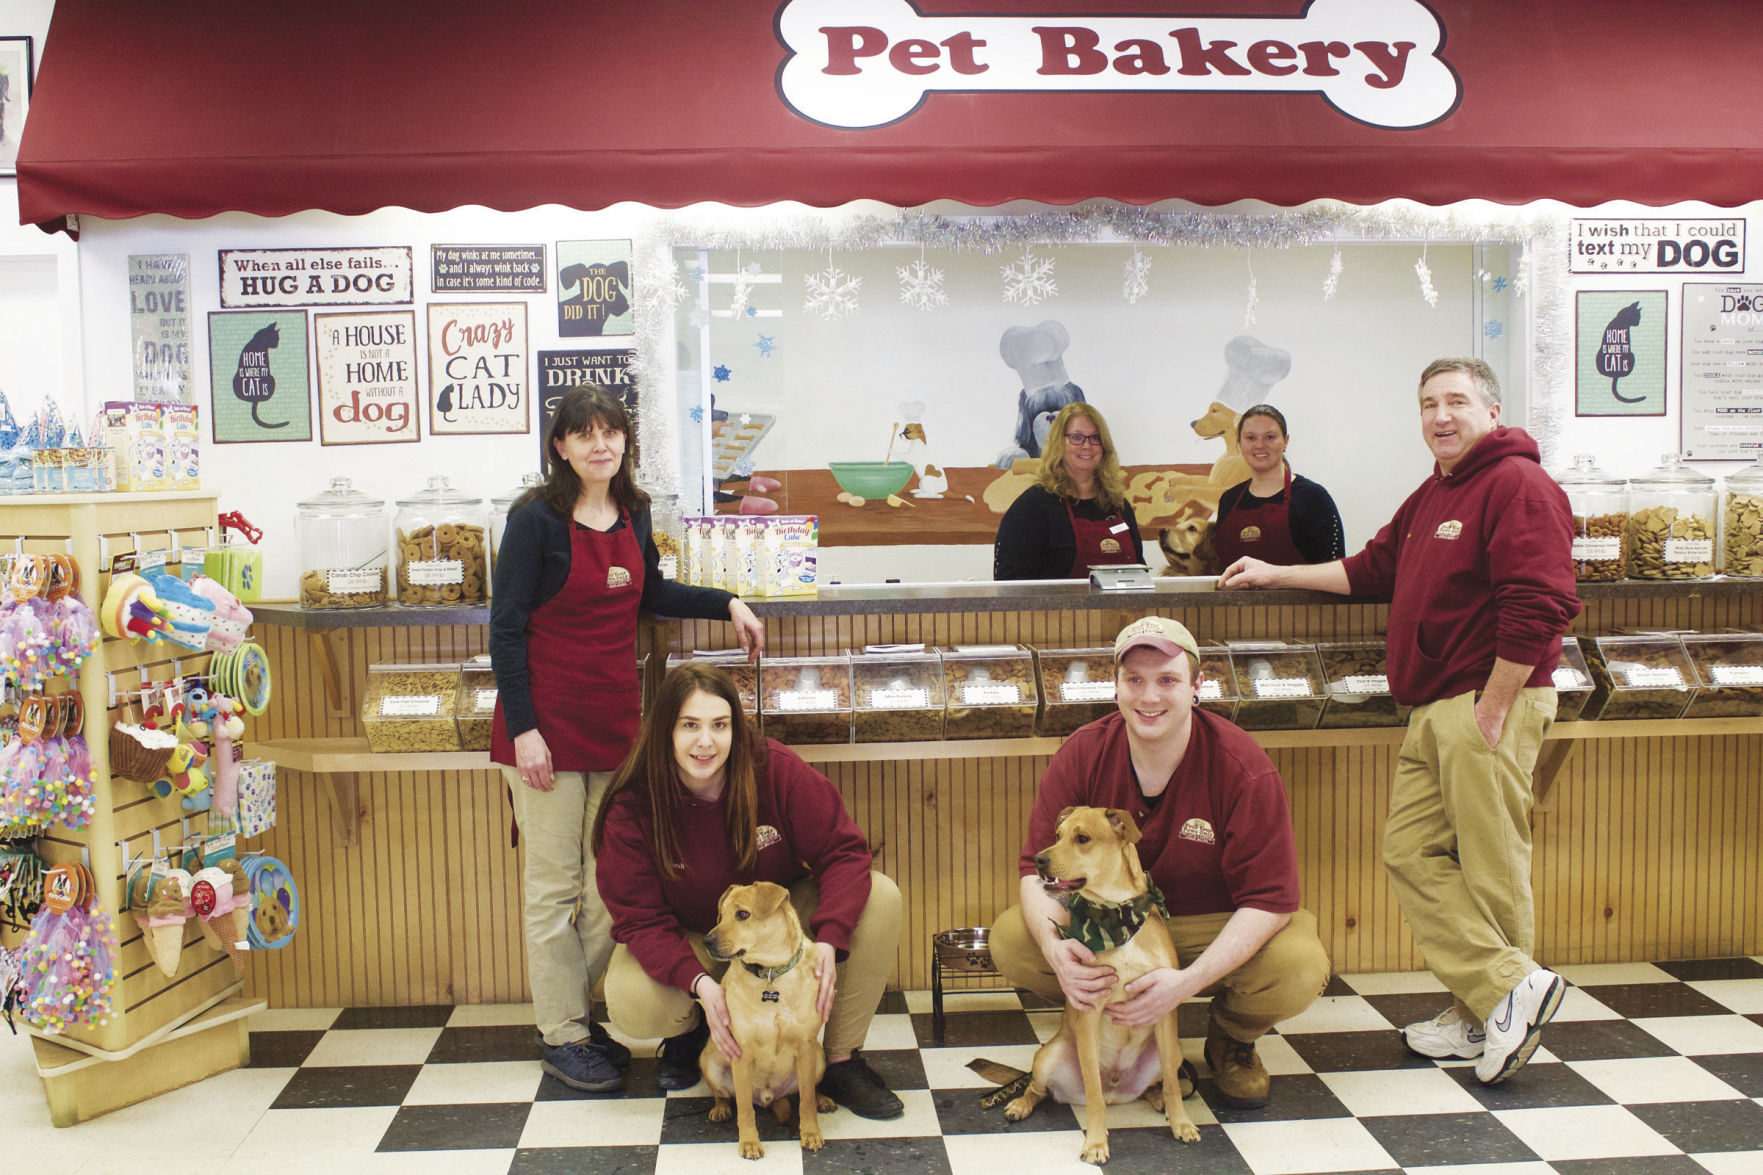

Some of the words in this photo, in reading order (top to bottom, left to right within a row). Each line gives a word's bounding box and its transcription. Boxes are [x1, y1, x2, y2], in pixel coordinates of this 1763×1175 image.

[818, 25, 990, 76] Pet
[1031, 25, 1417, 89] Bakery
[1577, 223, 1583, 237] I
[1589, 223, 1629, 237] wish
[1634, 223, 1667, 237] that
[1675, 223, 1681, 237] I
[1688, 223, 1737, 237] could
[436, 250, 446, 262] My
[447, 250, 460, 262] dog
[461, 250, 479, 260] winks
[481, 251, 489, 260] at
[490, 251, 501, 260] me
[1577, 240, 1615, 255] text
[1620, 243, 1653, 260] my
[1656, 239, 1739, 268] DOG
[233, 259, 281, 272] When
[285, 258, 306, 271] all
[310, 258, 343, 270] else
[347, 257, 399, 269] fails...
[449, 263, 462, 273] and
[469, 262, 492, 275] always
[494, 262, 512, 273] wink
[513, 262, 530, 273] back
[240, 275, 299, 295] HUG
[306, 274, 324, 294] A
[331, 273, 396, 293] DOG
[436, 276, 444, 287] in
[446, 277, 460, 287] case
[462, 276, 474, 287] it's
[476, 277, 495, 287] some
[496, 275, 512, 287] kind
[514, 276, 522, 288] of
[581, 276, 617, 302] DOG
[131, 290, 185, 314] LOVE
[563, 305, 583, 320] DID
[160, 318, 176, 328] BUT
[332, 328, 340, 346] A
[345, 324, 406, 347] HOUSE
[441, 317, 515, 356] Crazy
[1606, 329, 1628, 343] HOME
[144, 340, 189, 364] DOG
[243, 352, 266, 366] HOME
[360, 349, 367, 359] IS
[368, 349, 383, 359] NOT
[385, 349, 390, 358] A
[552, 357, 578, 366] JUST
[582, 355, 613, 365] WANT
[617, 355, 631, 364] TO
[445, 354, 520, 380] CAT
[1604, 354, 1621, 371] CAT
[1623, 360, 1628, 371] IS
[244, 368, 260, 377] WHERE
[261, 368, 269, 377] MY
[346, 361, 408, 383] HOME
[546, 367, 632, 387] DRINK
[242, 378, 261, 396] CAT
[262, 384, 269, 396] IS
[365, 386, 396, 397] WITHOUT
[399, 387, 404, 396] A
[457, 382, 520, 410] LADY
[333, 390, 410, 432] dog
[776, 526, 809, 536] Birthday
